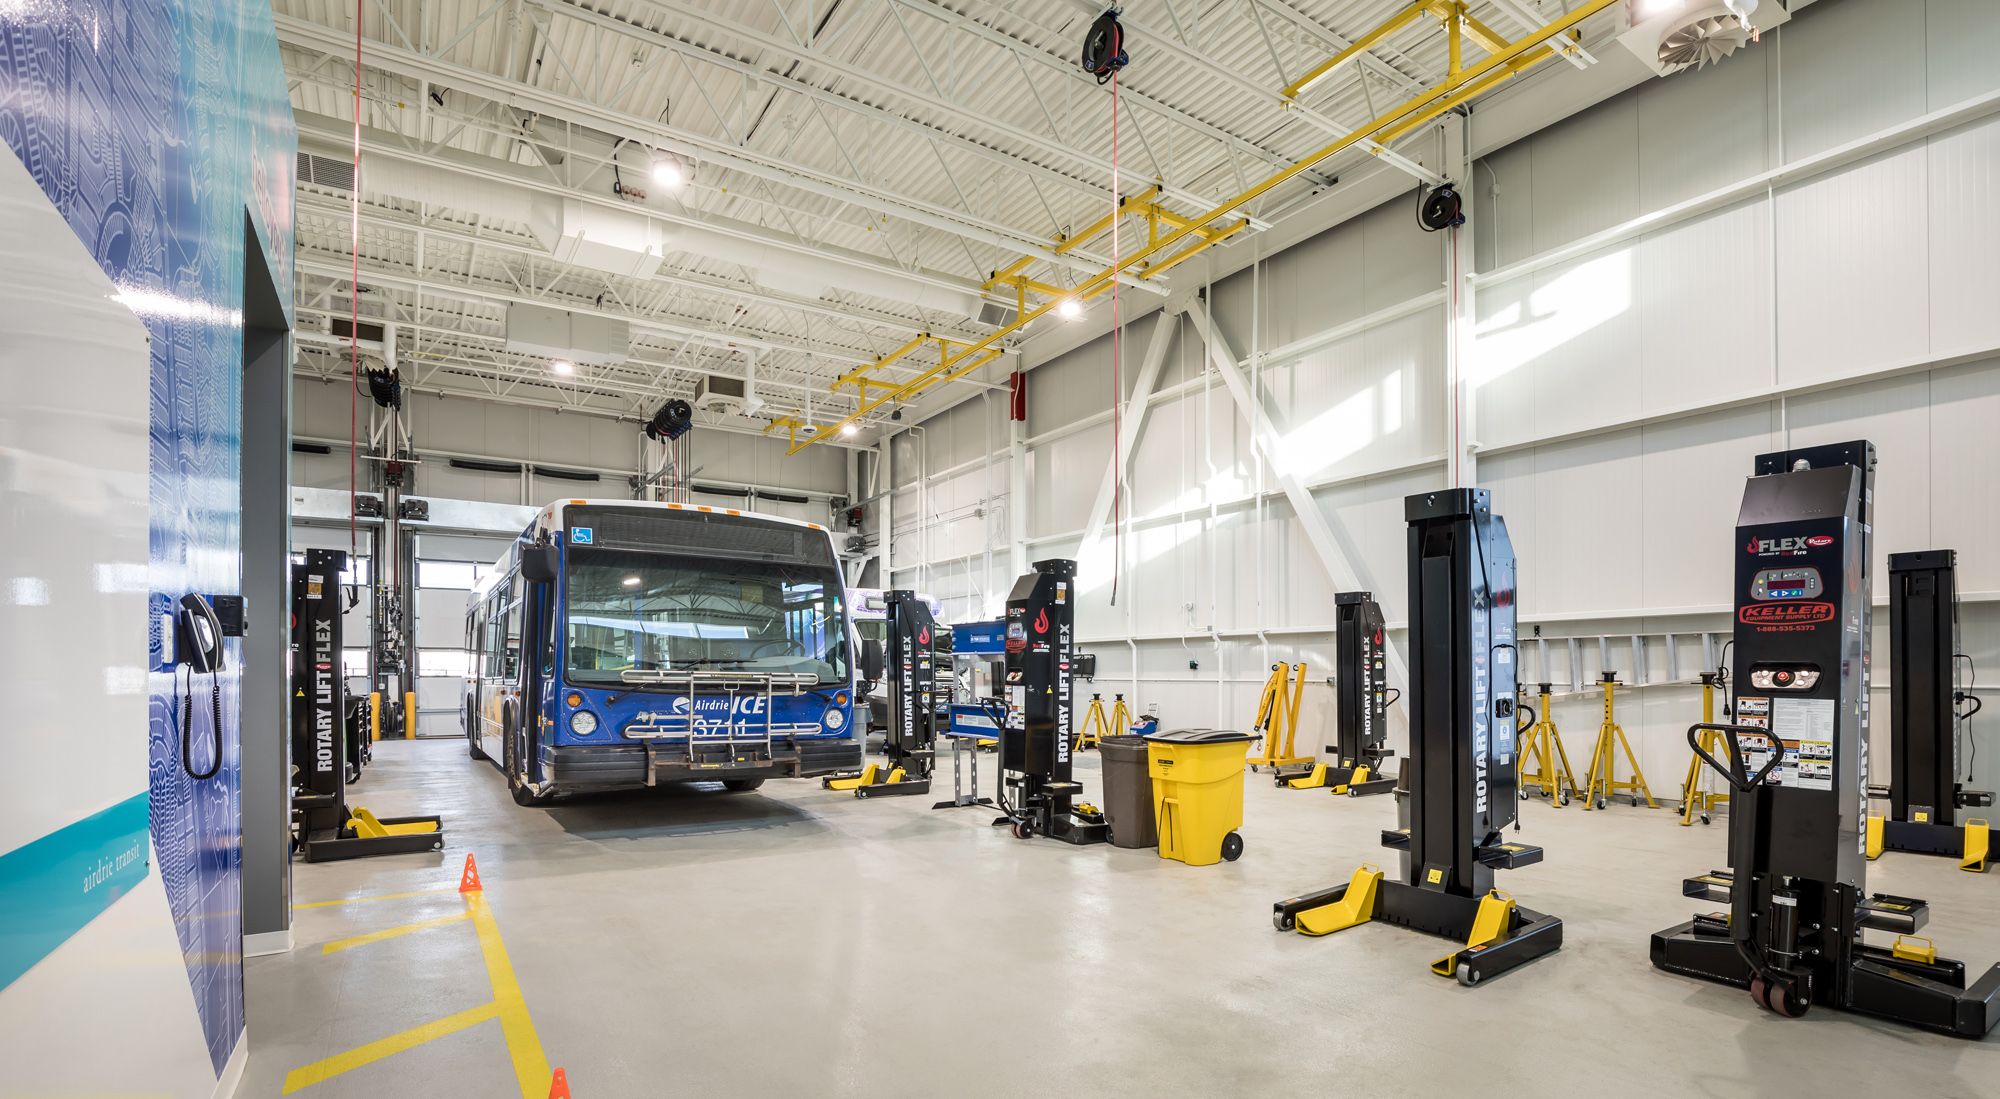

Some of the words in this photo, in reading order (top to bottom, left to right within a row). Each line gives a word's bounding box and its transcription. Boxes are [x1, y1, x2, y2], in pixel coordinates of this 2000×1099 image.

[1758, 536, 1808, 552] FLEX
[1474, 590, 1485, 653] FLEX
[1745, 605, 1829, 616] KELLER
[315, 619, 331, 663] FLEX
[903, 635, 912, 665] FLEX
[1059, 623, 1070, 663] FLEX
[316, 671, 332, 704] LIFT
[903, 669, 913, 692] LIFT
[1058, 670, 1070, 701] LIFT
[1363, 669, 1371, 692] LIFT
[1475, 666, 1486, 714] LIFT
[1861, 667, 1870, 728] LIFT
[694, 699, 729, 711] Airdrie
[731, 696, 767, 714] ICE
[904, 694, 914, 737] ROTARY
[316, 708, 333, 772] ROTARY
[1057, 704, 1069, 763] ROTARY
[1476, 721, 1487, 814] ROTARY
[1858, 737, 1869, 855] ROTARY
[83, 855, 113, 894] airdrie
[115, 839, 140, 872] transit
